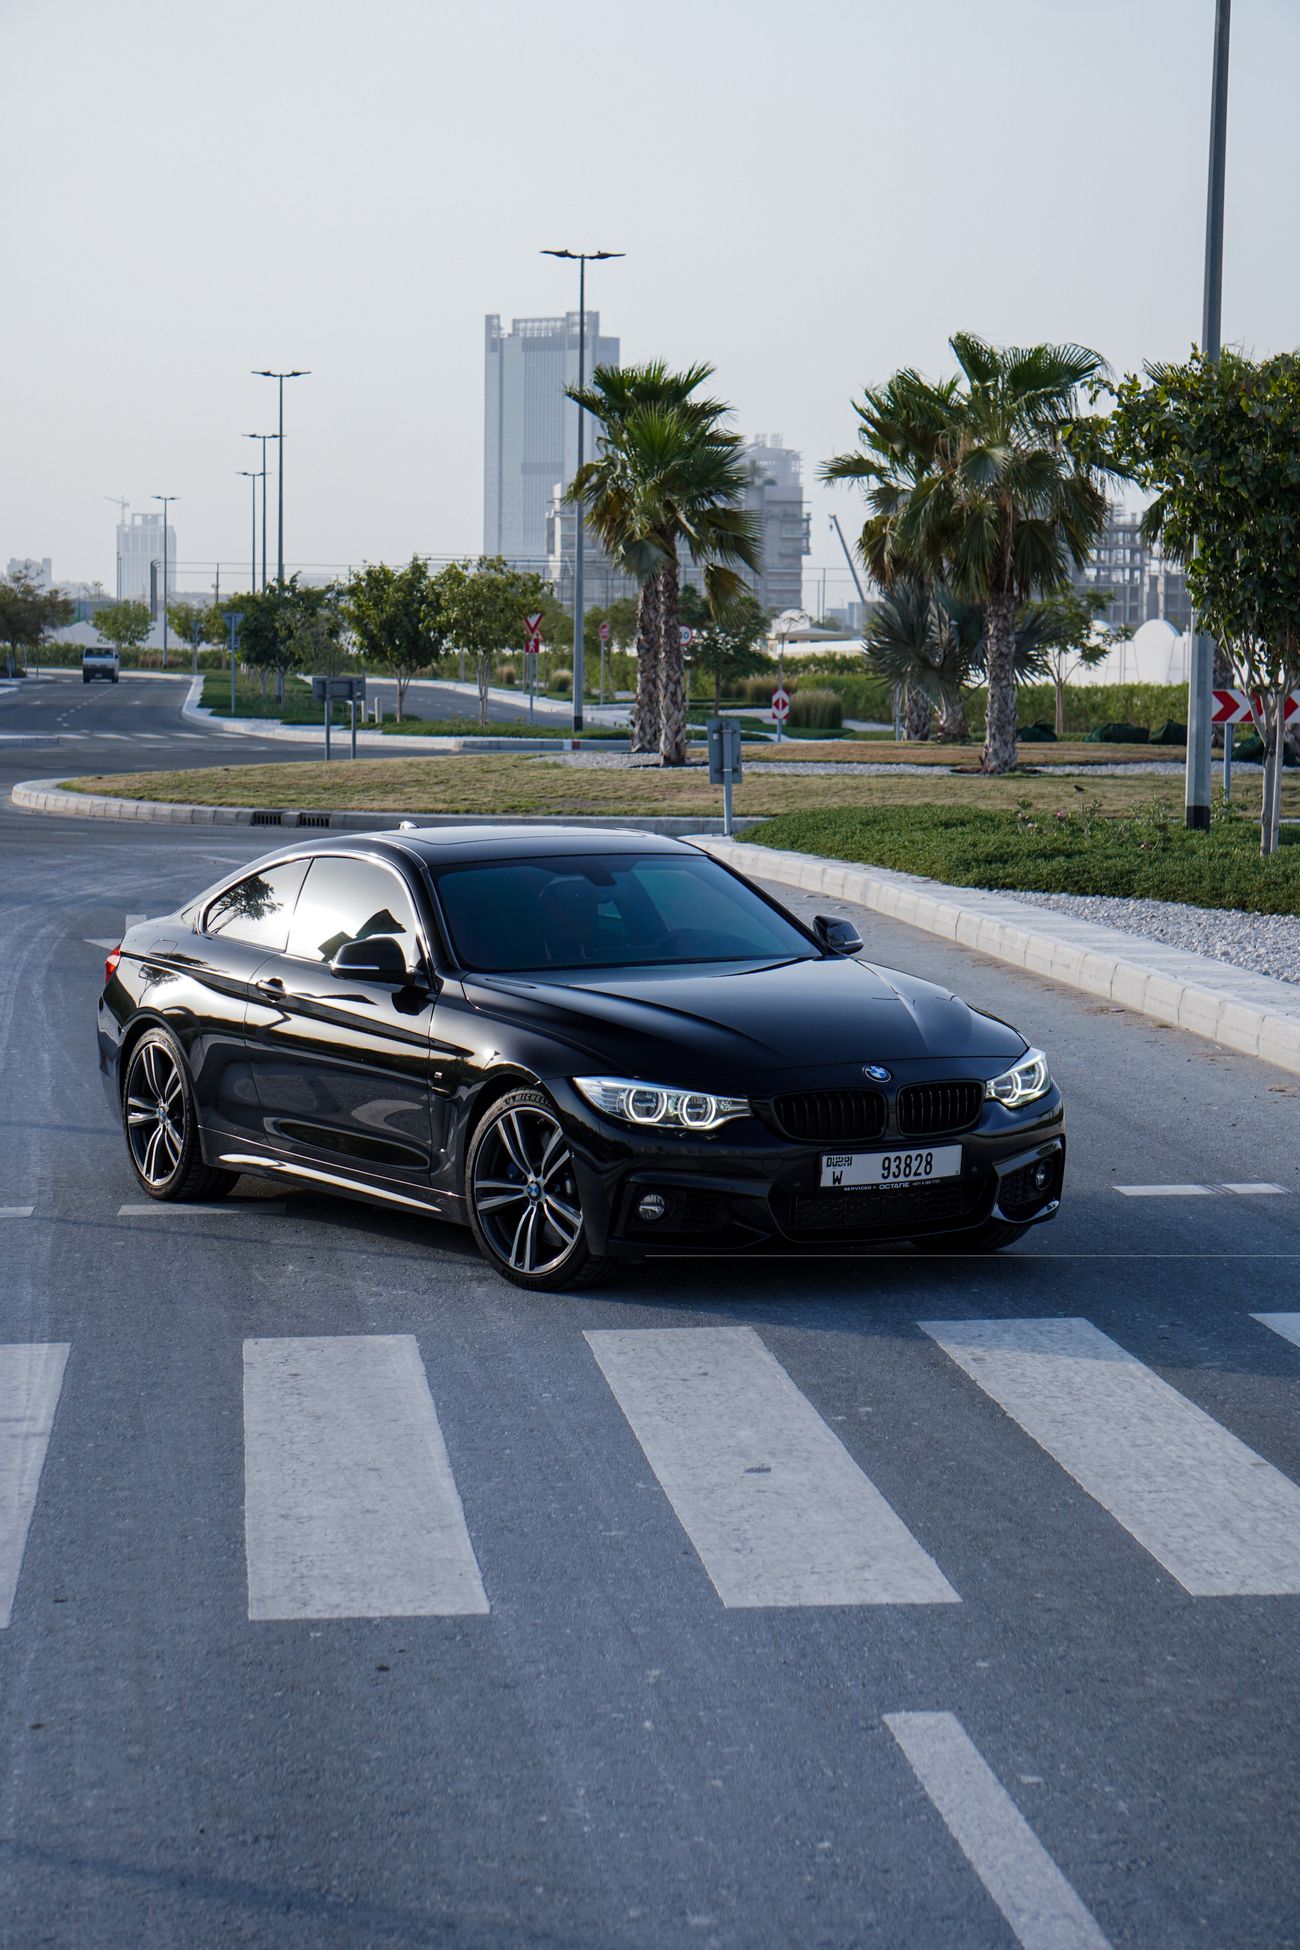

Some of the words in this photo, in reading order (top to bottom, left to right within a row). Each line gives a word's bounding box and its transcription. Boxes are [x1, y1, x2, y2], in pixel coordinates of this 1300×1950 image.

[826, 1156, 853, 1167] DUBAI
[881, 1152, 934, 1180] 93828
[832, 1170, 843, 1185] W
[878, 1181, 910, 1190] OCTANE
